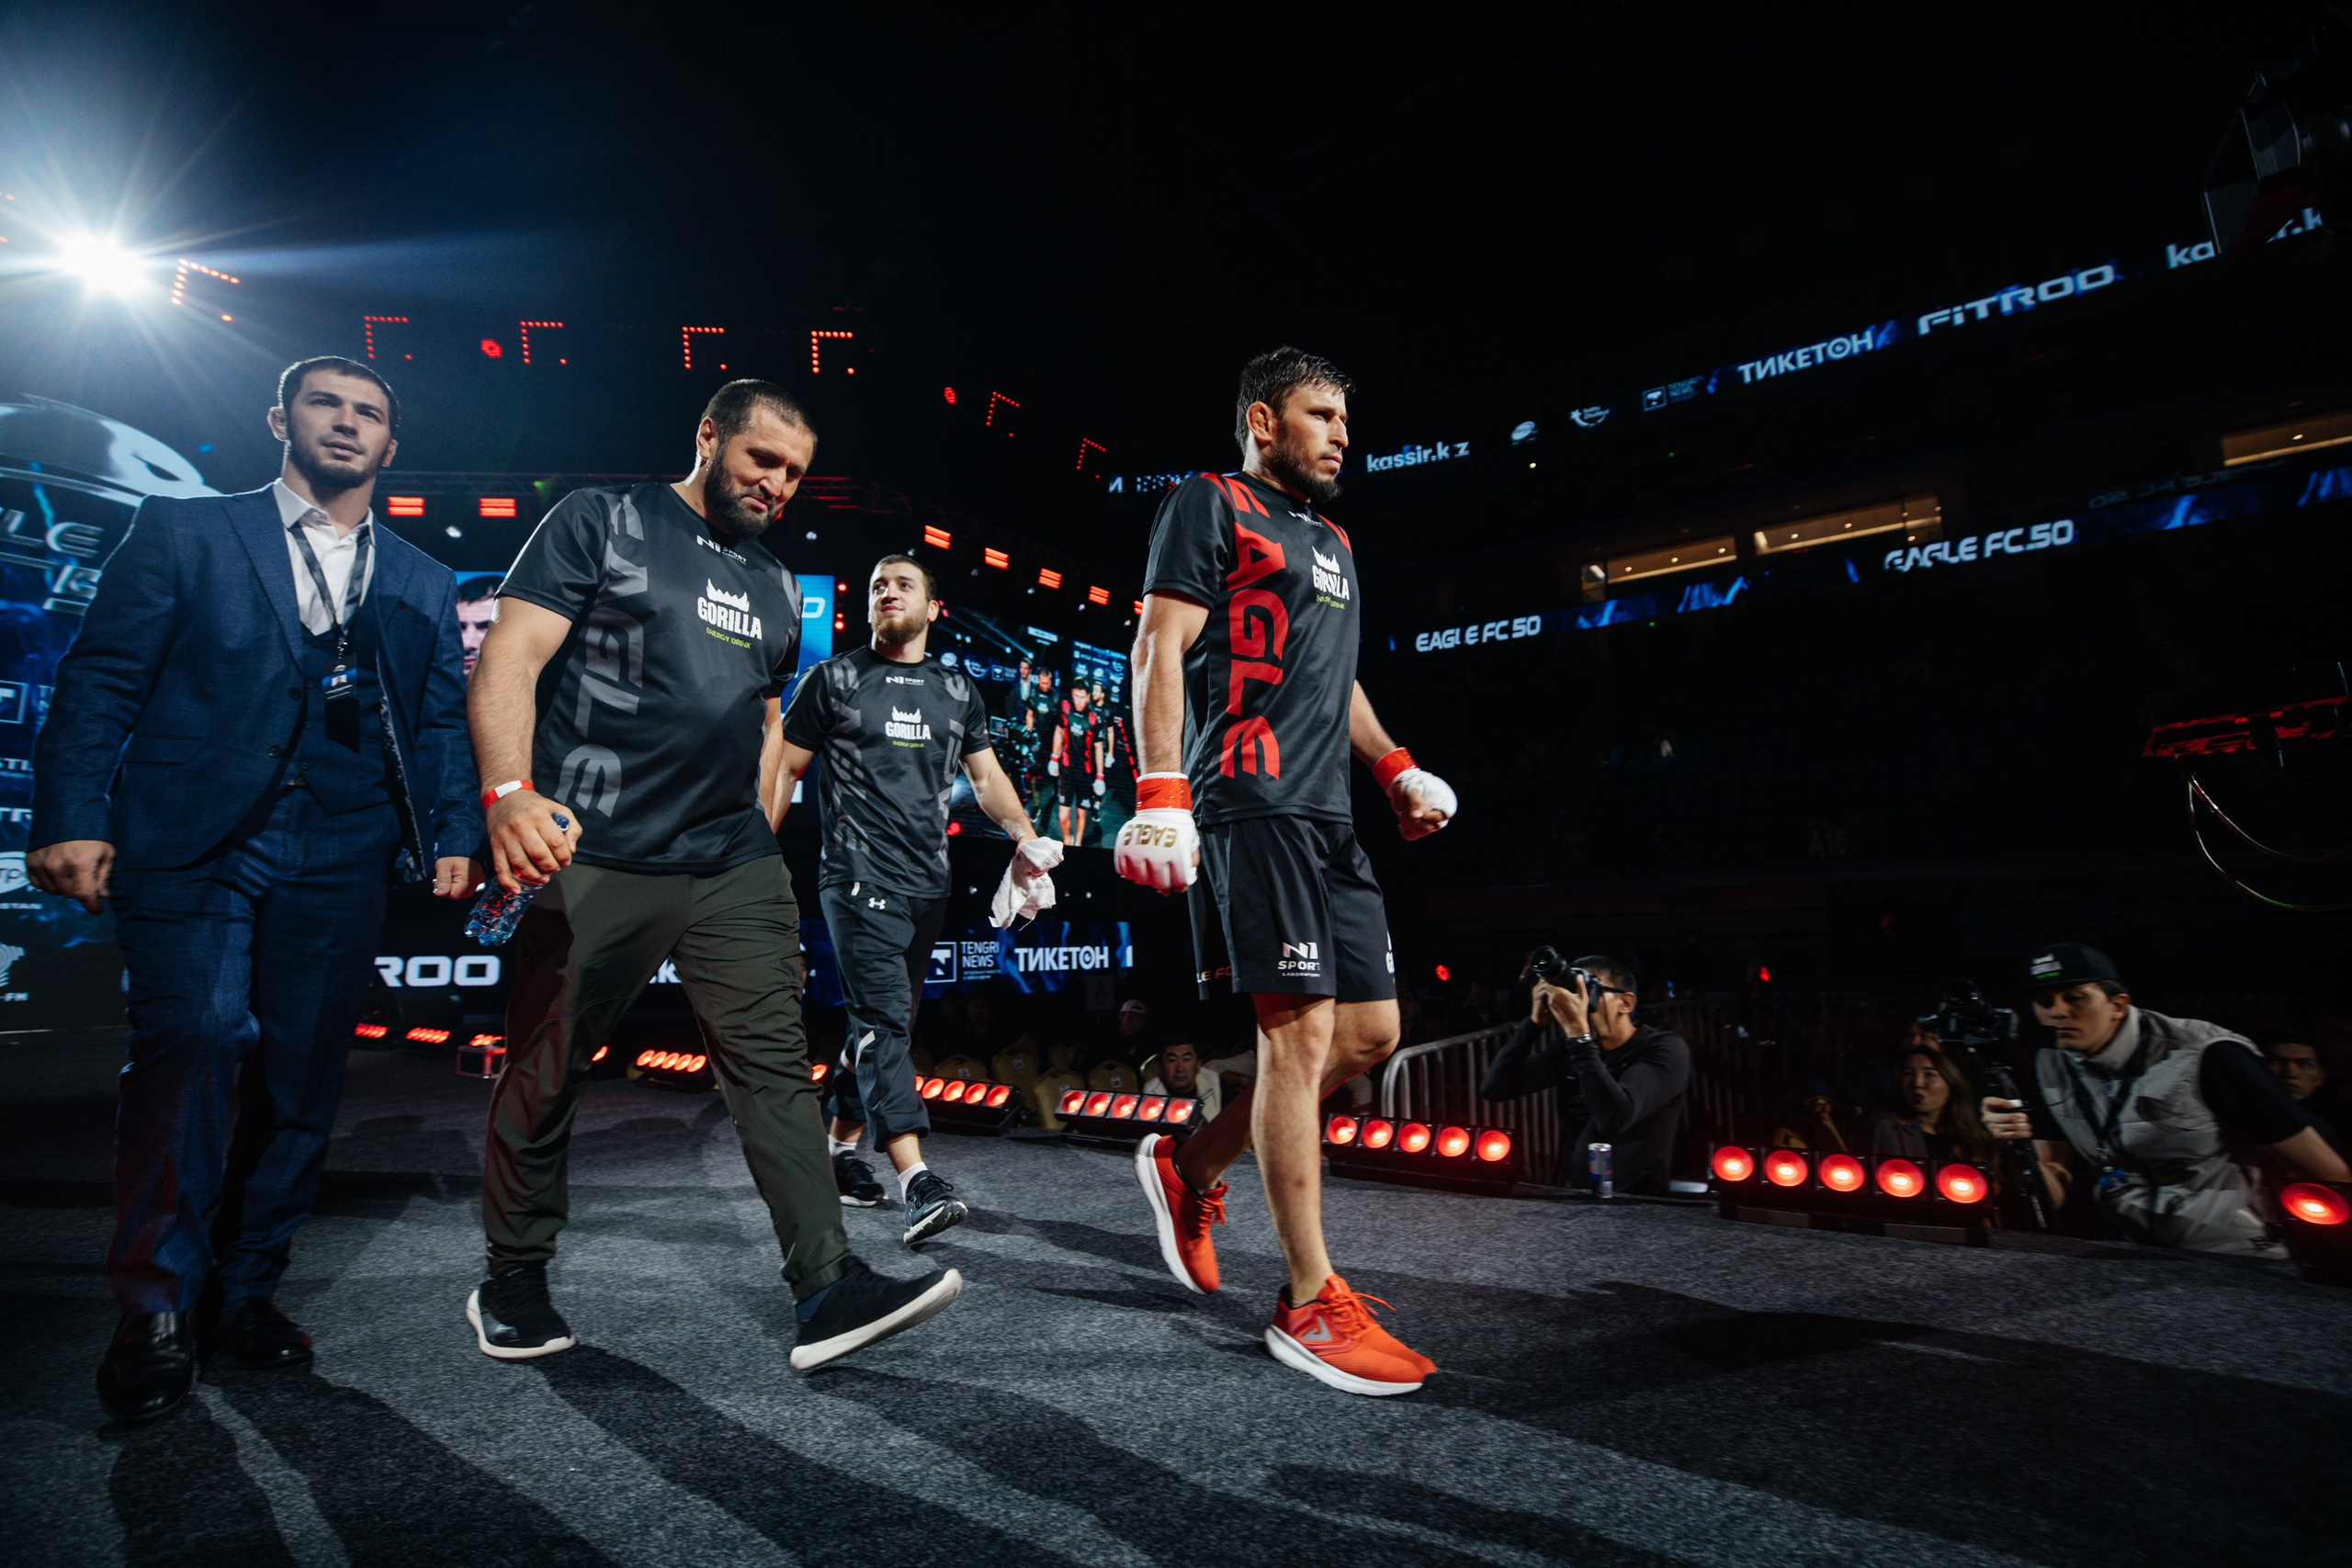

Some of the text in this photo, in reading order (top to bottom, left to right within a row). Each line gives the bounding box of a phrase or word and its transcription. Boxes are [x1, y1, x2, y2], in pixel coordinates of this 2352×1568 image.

[1736, 330, 1875, 385] ТИКЕТОН
[1883, 535, 1979, 573] EAGLE
[1983, 526, 2025, 559] FC
[696, 596, 763, 641] GORILLA
[706, 626, 752, 649] ENERGY DRINK
[1415, 615, 1543, 652] EAGLE FC 50
[885, 721, 932, 740] GORILLA
[960, 941, 1000, 954] TENGRI
[962, 954, 995, 968] NEWS
[1013, 944, 1110, 972] ТИКЕТОН
